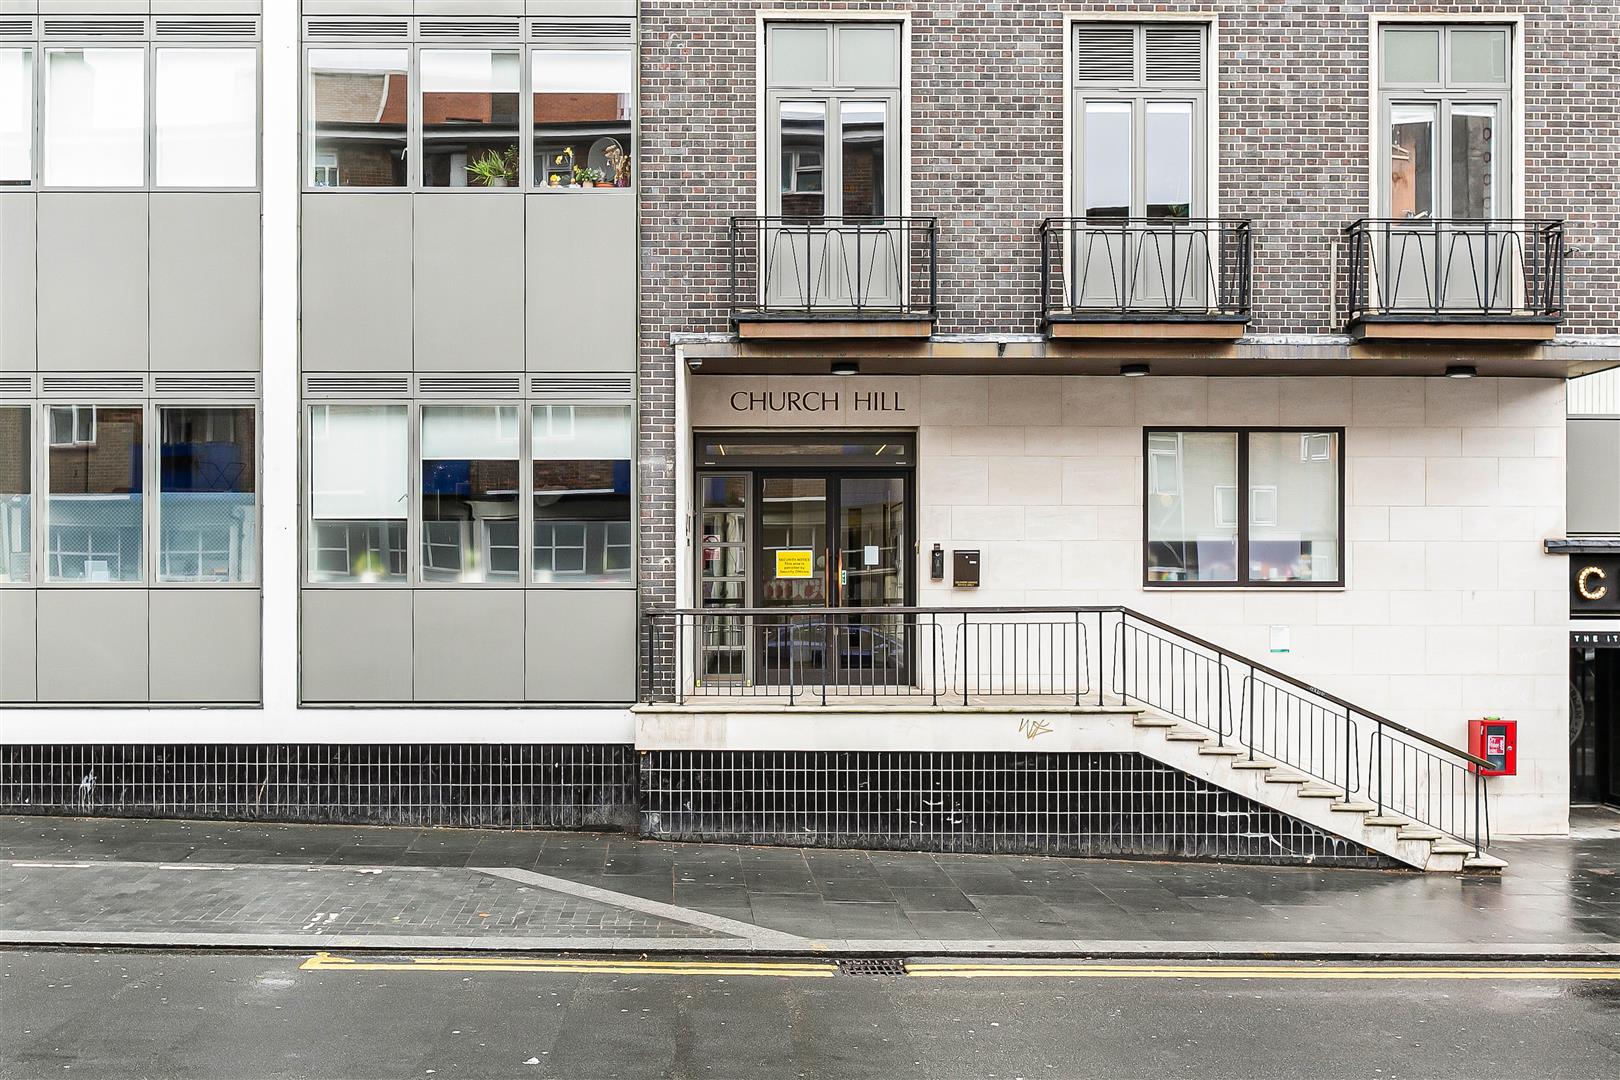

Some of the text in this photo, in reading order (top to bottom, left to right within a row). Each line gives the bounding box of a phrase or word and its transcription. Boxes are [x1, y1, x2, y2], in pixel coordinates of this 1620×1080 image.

[730, 391, 906, 412] CHURCH HILL
[1576, 566, 1607, 600] C
[1574, 635, 1599, 643] THE
